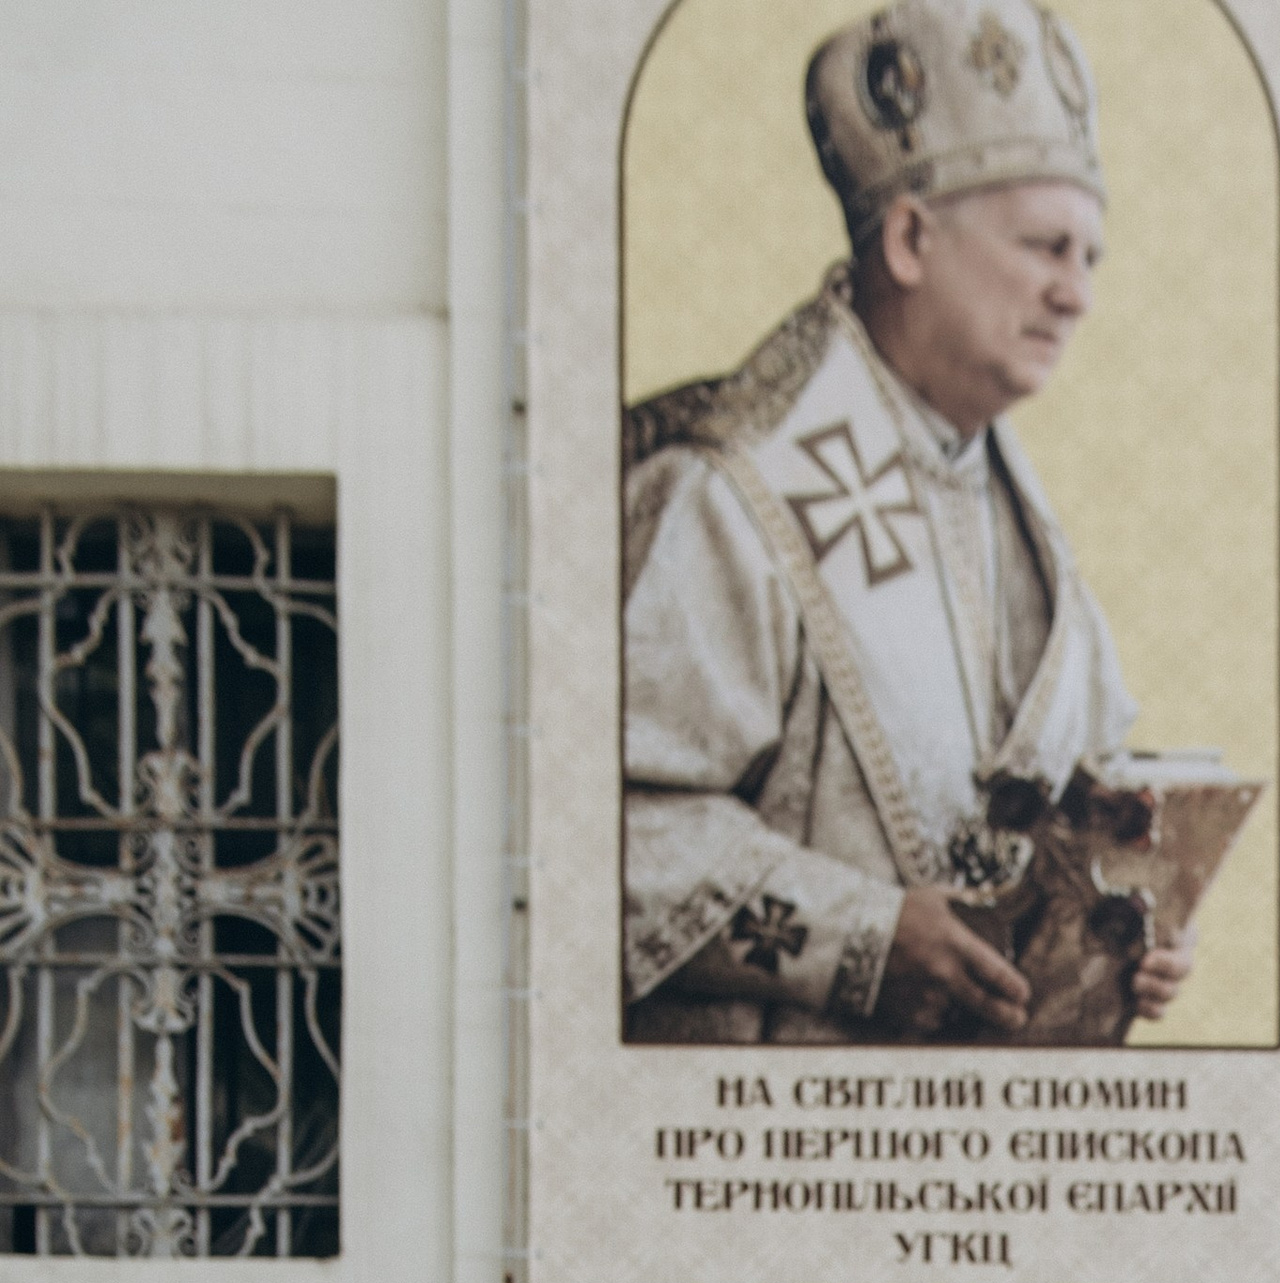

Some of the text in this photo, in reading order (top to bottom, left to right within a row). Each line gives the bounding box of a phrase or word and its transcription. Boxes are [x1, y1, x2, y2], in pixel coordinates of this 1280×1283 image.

[715, 1071, 1188, 1110] НА СВІТЛИЙ СПОМИН
[654, 1127, 1246, 1163] ПРО ПЕРШОГО ЄПИСКОПА
[664, 1175, 1237, 1214] ТЕРНОПІЛЬСЬКОЇ ЄПАРХІЇ
[893, 1231, 1013, 1268] УГКЦ
